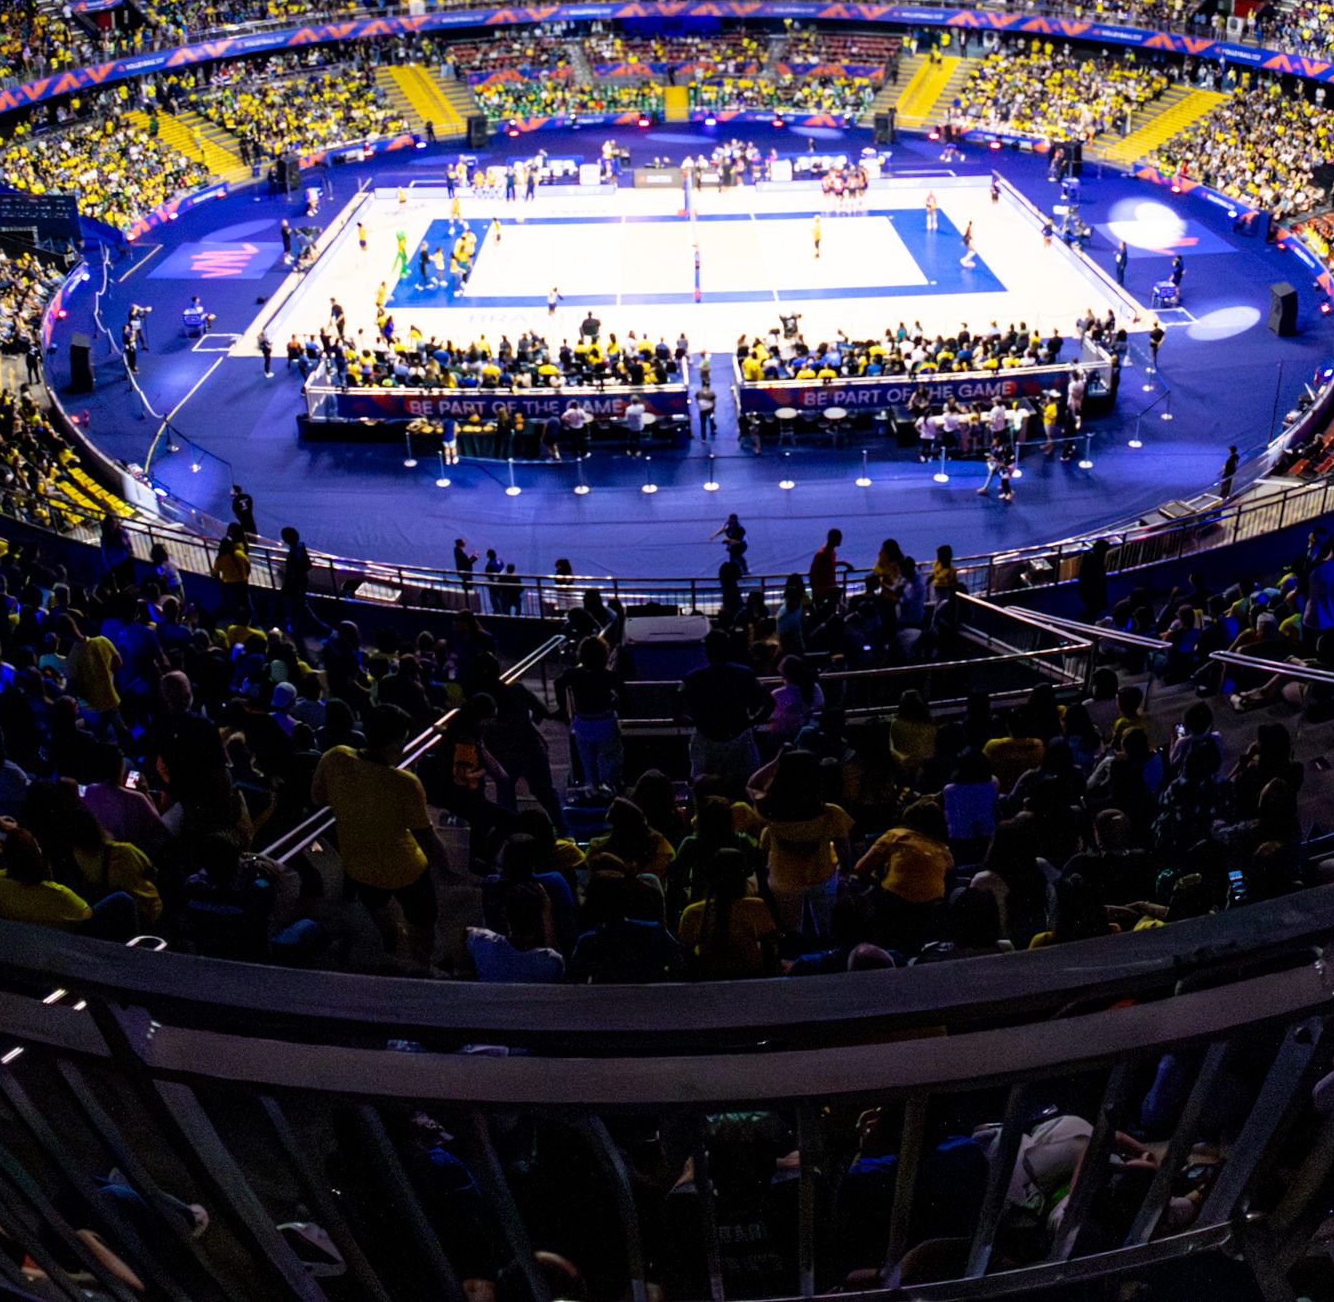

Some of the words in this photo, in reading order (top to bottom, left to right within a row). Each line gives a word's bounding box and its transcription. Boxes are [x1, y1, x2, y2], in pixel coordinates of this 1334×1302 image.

[803, 391, 827, 406] BE
[834, 389, 881, 404] PART
[886, 387, 911, 403] OF
[924, 385, 953, 400] HE
[958, 380, 1013, 398] GAME
[409, 399, 433, 415] BE
[439, 400, 486, 415] PART
[522, 400, 560, 415] THE
